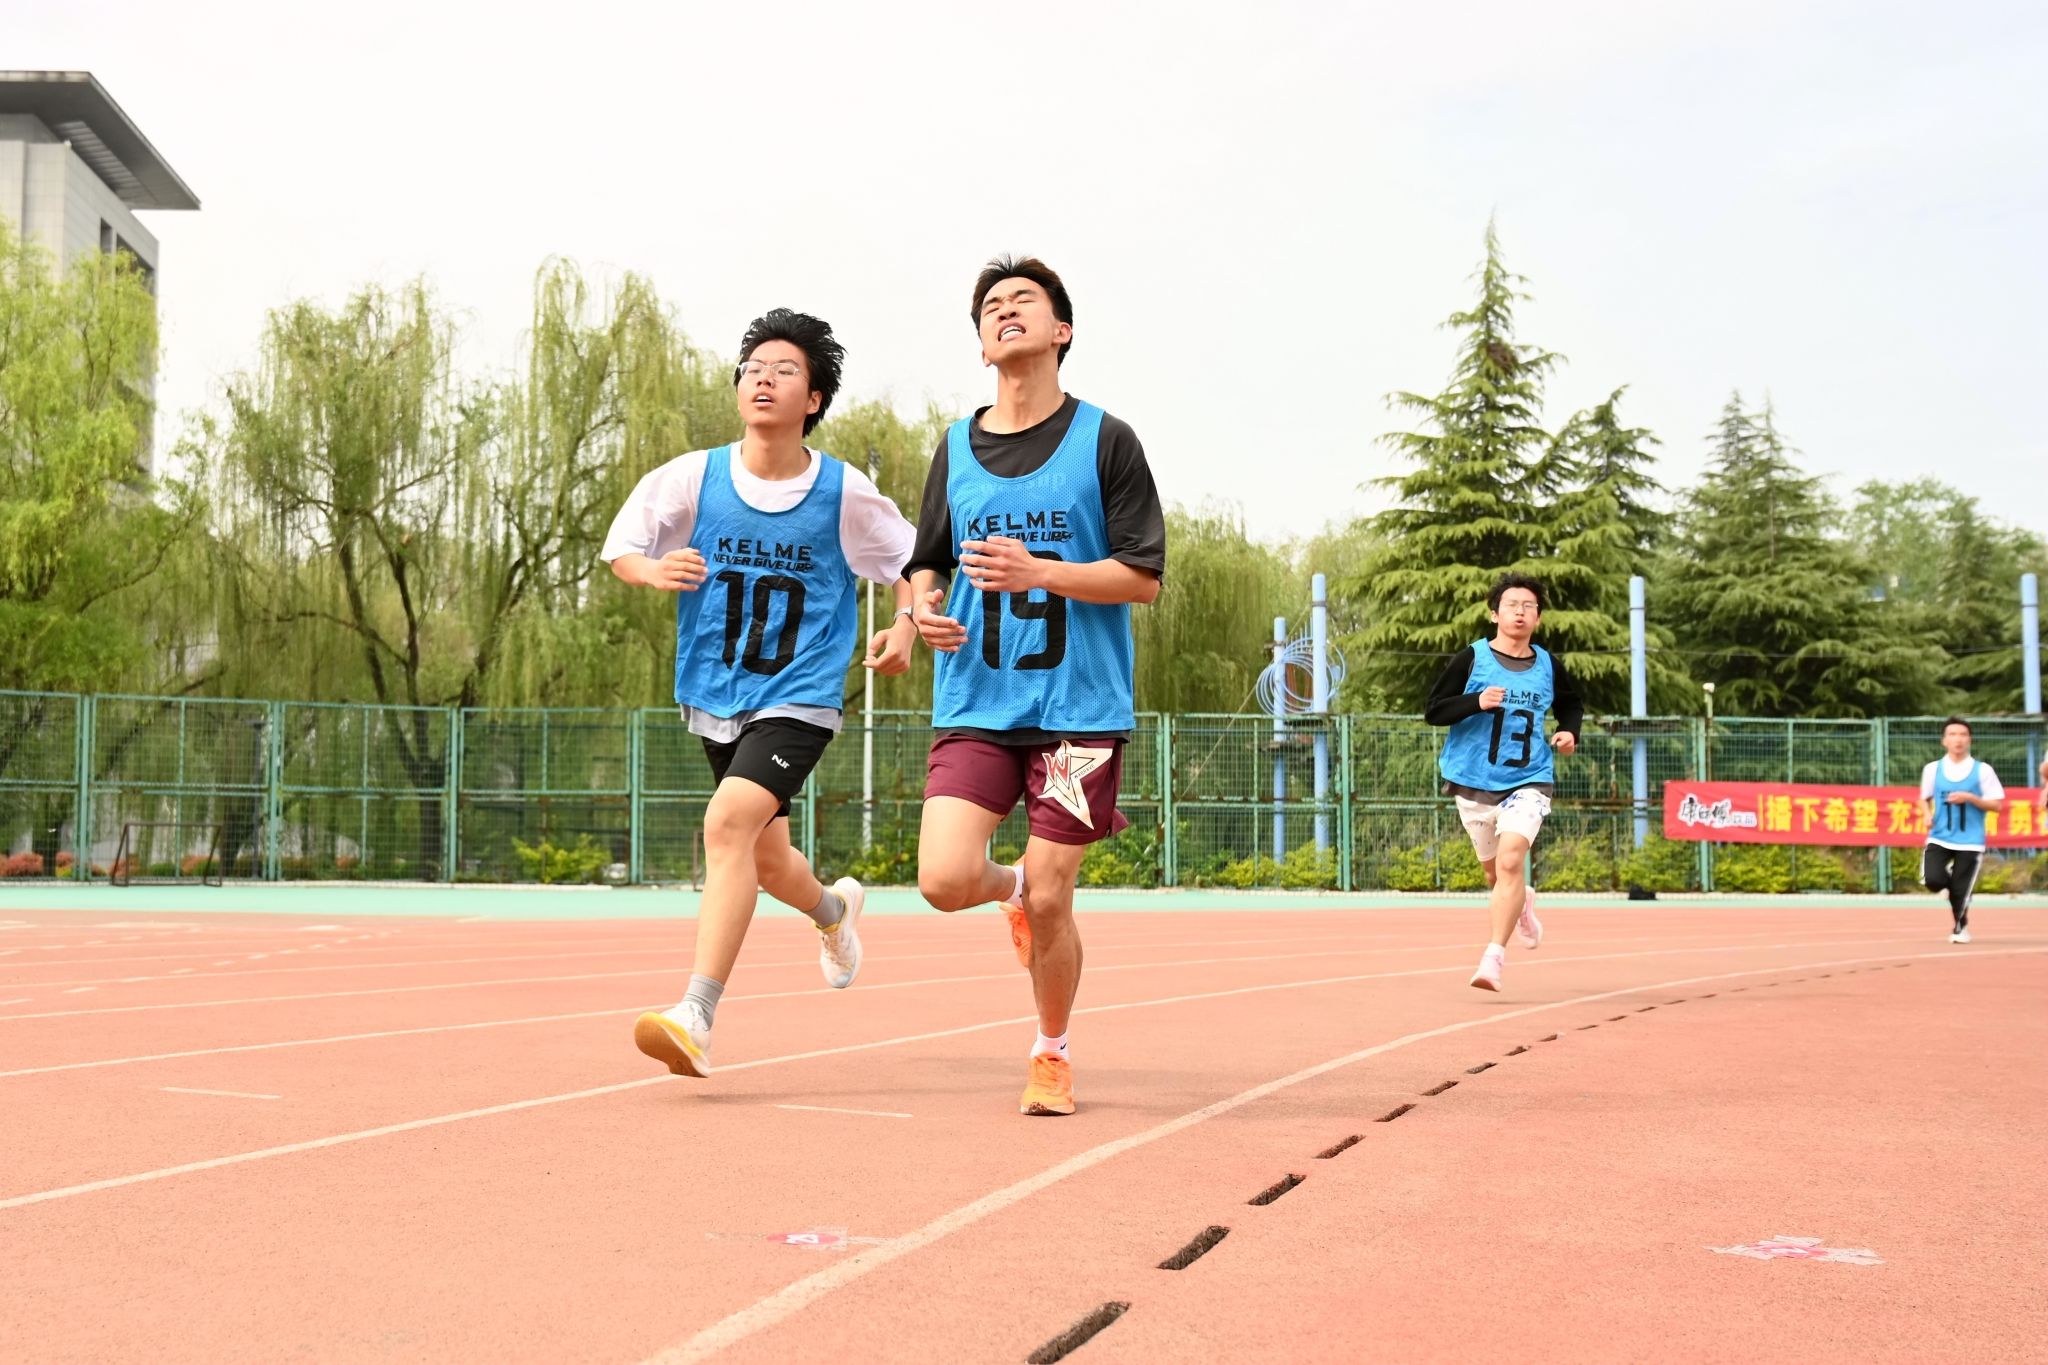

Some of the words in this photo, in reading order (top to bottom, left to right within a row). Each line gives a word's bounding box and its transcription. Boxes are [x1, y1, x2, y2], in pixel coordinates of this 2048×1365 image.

[968, 510, 1068, 537] KELME
[713, 553, 751, 566] NEVER
[754, 557, 785, 570] GIVE
[718, 537, 813, 561] KELME
[716, 570, 806, 676] 10
[979, 550, 1068, 670] 19
[1486, 706, 1534, 769] 13
[1766, 794, 1879, 834] 播下希望
